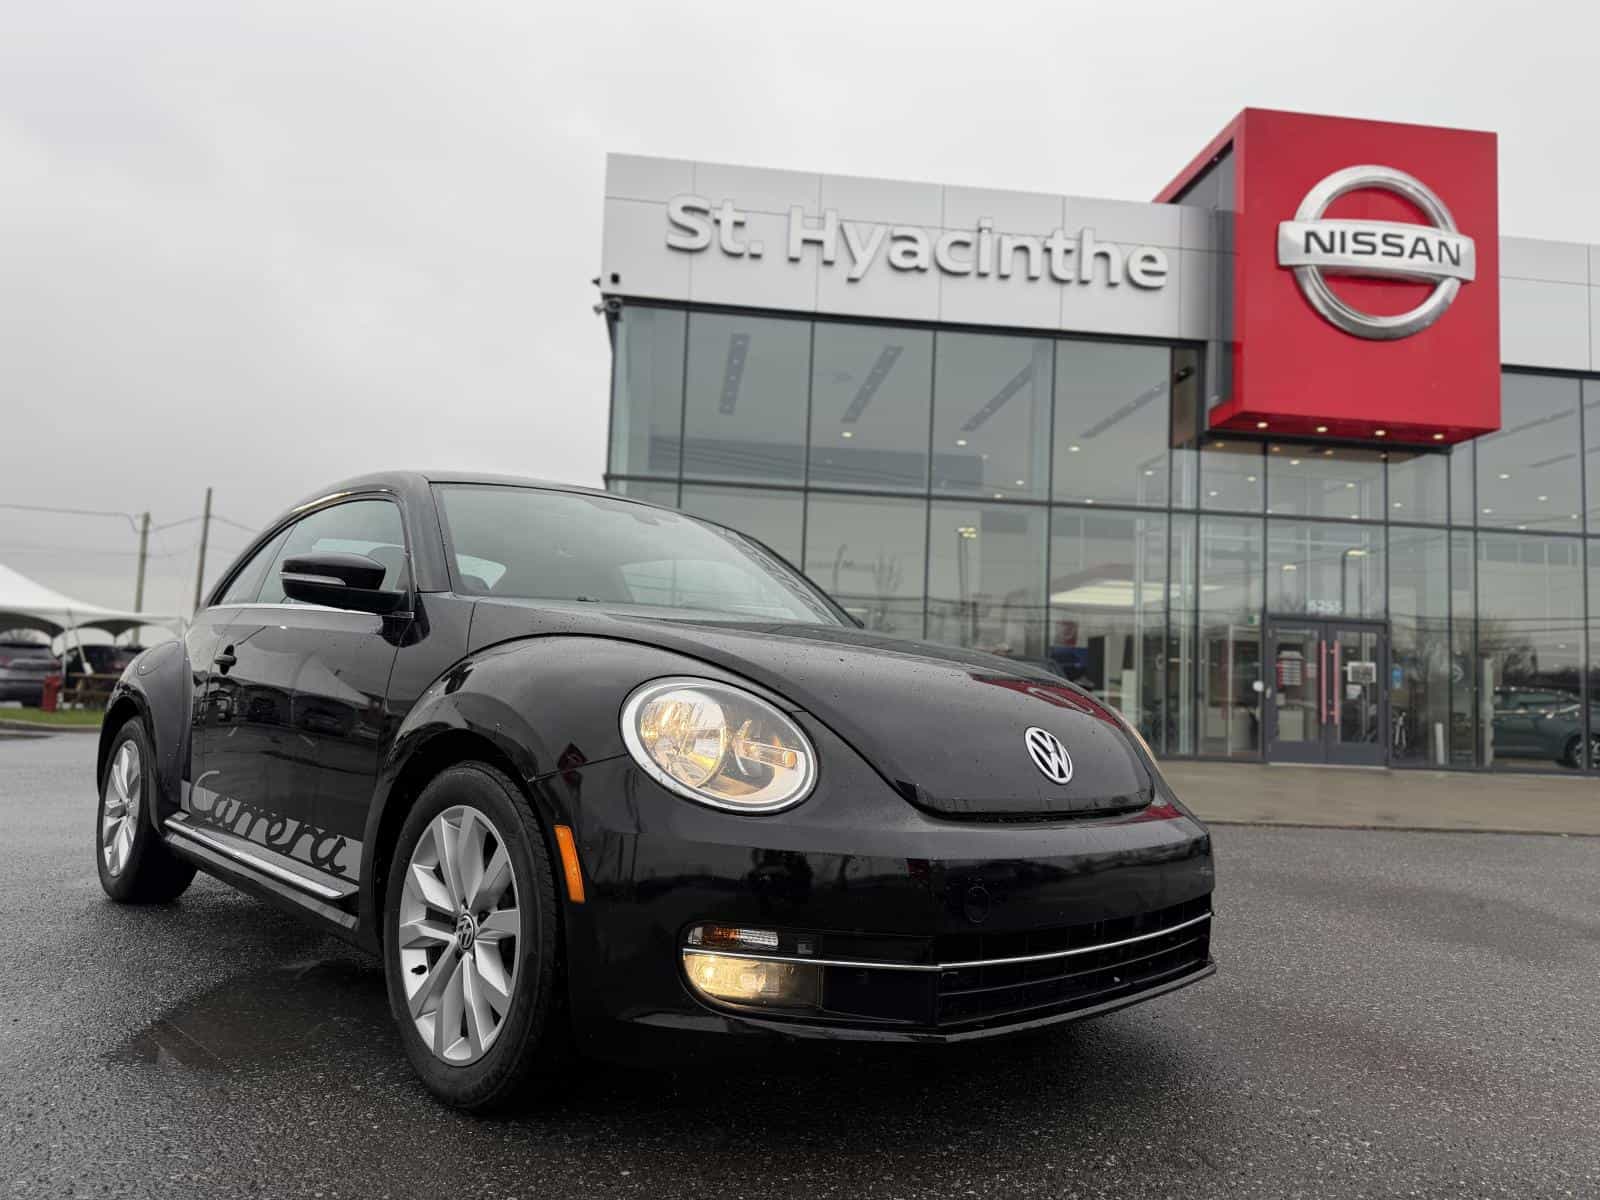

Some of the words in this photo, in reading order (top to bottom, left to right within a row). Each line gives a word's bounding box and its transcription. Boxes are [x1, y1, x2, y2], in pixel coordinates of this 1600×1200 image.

[666, 196, 763, 259] St.
[788, 204, 1168, 290] Hyacinthe
[1304, 230, 1461, 267] NISSAN
[1026, 728, 1072, 783] VW
